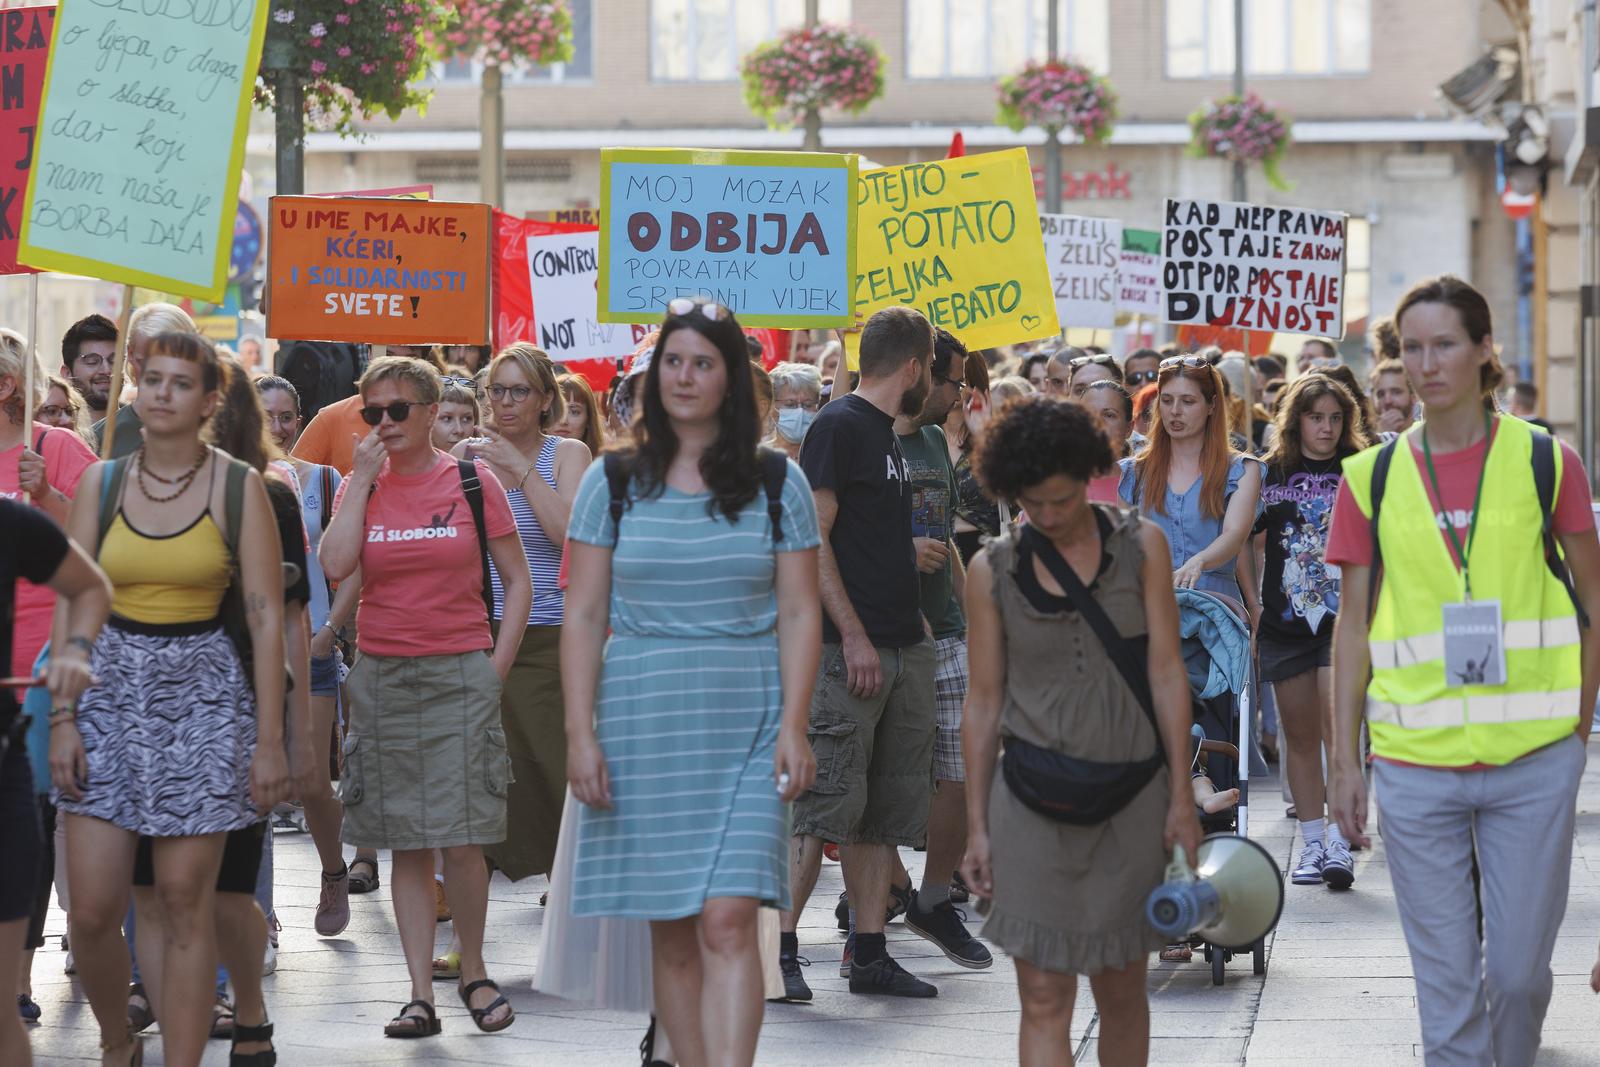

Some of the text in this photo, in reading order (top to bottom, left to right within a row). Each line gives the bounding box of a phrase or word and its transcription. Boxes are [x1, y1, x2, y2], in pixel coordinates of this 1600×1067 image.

[0, 9, 56, 52] RA
[134, 118, 187, 174] koji
[45, 161, 212, 226] nam naša je
[626, 175, 832, 205] MOJ MOZAK
[29, 199, 204, 256] BORBA DALA
[280, 209, 467, 243] U IME MAJKE,
[627, 211, 830, 256] ODBIJA
[878, 200, 1016, 255] POTATO
[1165, 199, 1344, 239] KAD NEPRAVDA
[326, 230, 402, 266] KĆERI,
[532, 246, 599, 278] CONTROL
[1165, 229, 1342, 261] POSTAJE ZAKON
[290, 264, 467, 292] I SOLIDARNOSTI
[624, 258, 805, 281] POVRATAK U
[1163, 260, 1339, 307] OTPOR POSTAJE
[772, 288, 841, 312] VIJEK
[1167, 292, 1335, 333] DUŽNOST
[540, 318, 577, 351] NOT
[367, 530, 384, 542] ZA
[387, 526, 458, 542] SLOBODU
